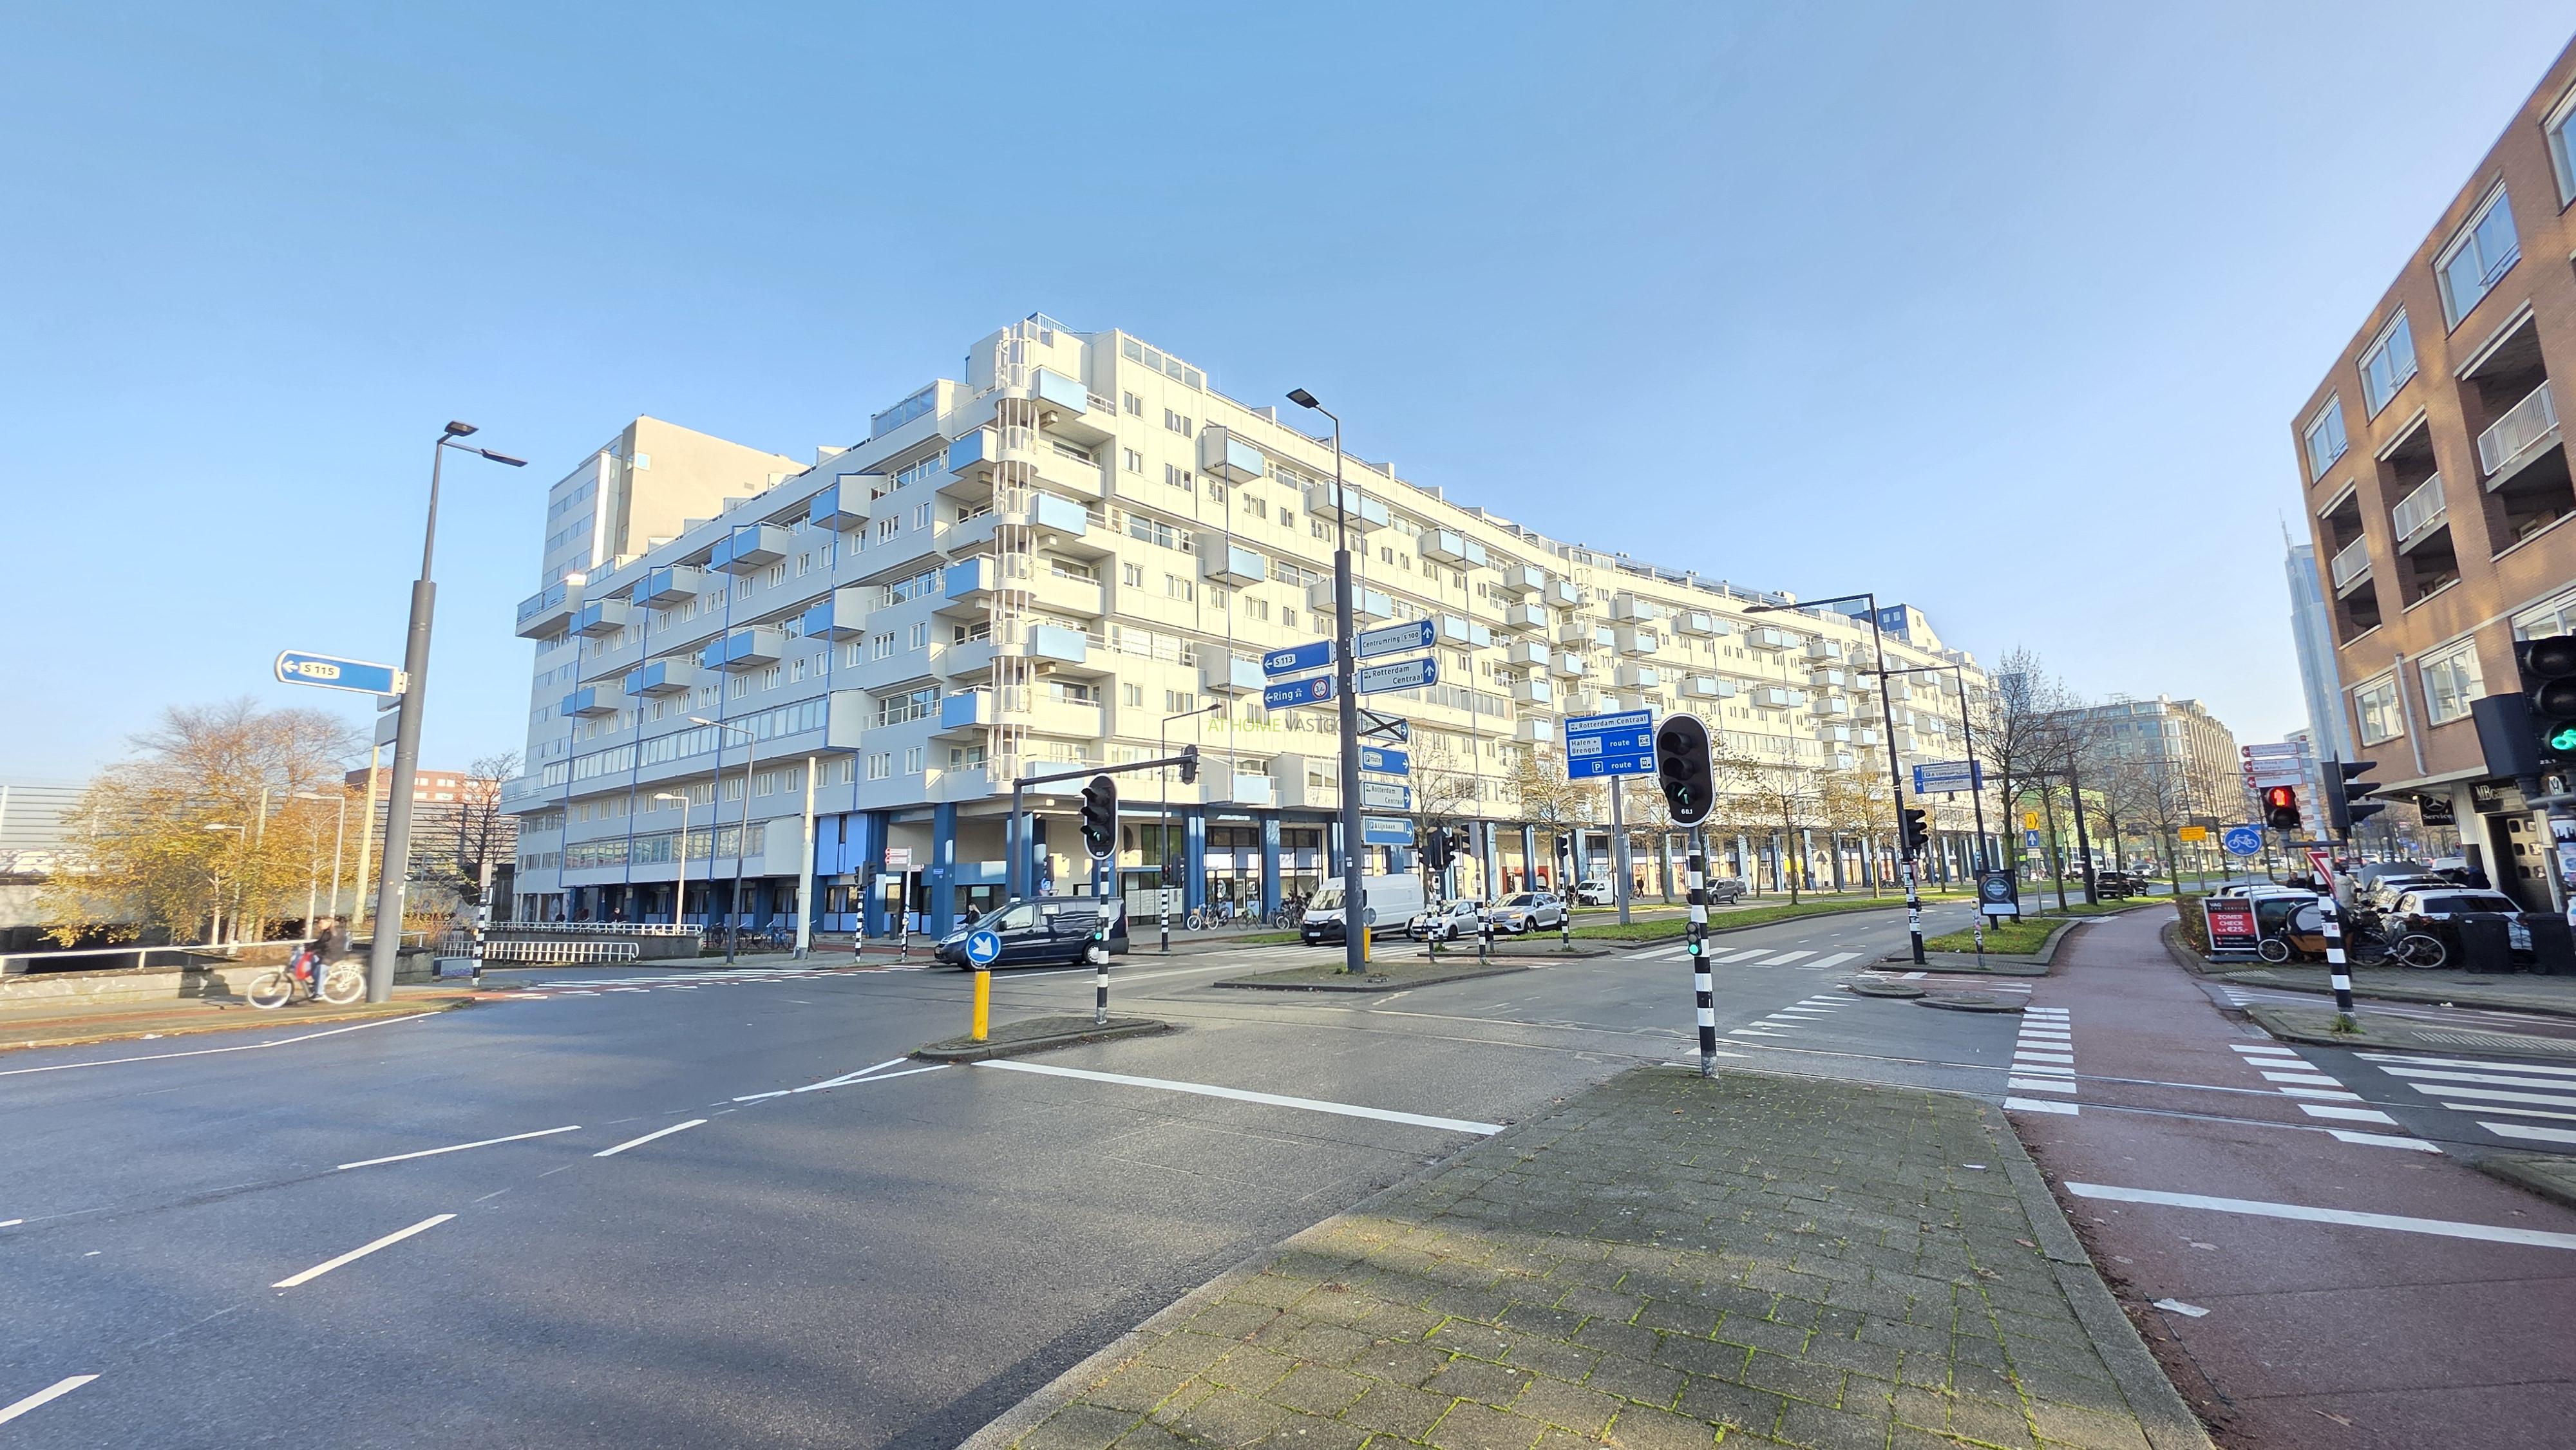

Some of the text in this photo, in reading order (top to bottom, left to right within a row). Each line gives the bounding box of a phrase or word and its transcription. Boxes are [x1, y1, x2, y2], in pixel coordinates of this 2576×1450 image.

[1363, 636, 1400, 648] Centrumring
[304, 664, 335, 675] S 115
[1372, 666, 1410, 677] Rotterdam
[1392, 673, 1423, 684] Centraal
[1273, 691, 1293, 701] Ring
[1579, 715, 1646, 729] Rotterdam Centraal
[1371, 786, 1396, 794] Rotterdam
